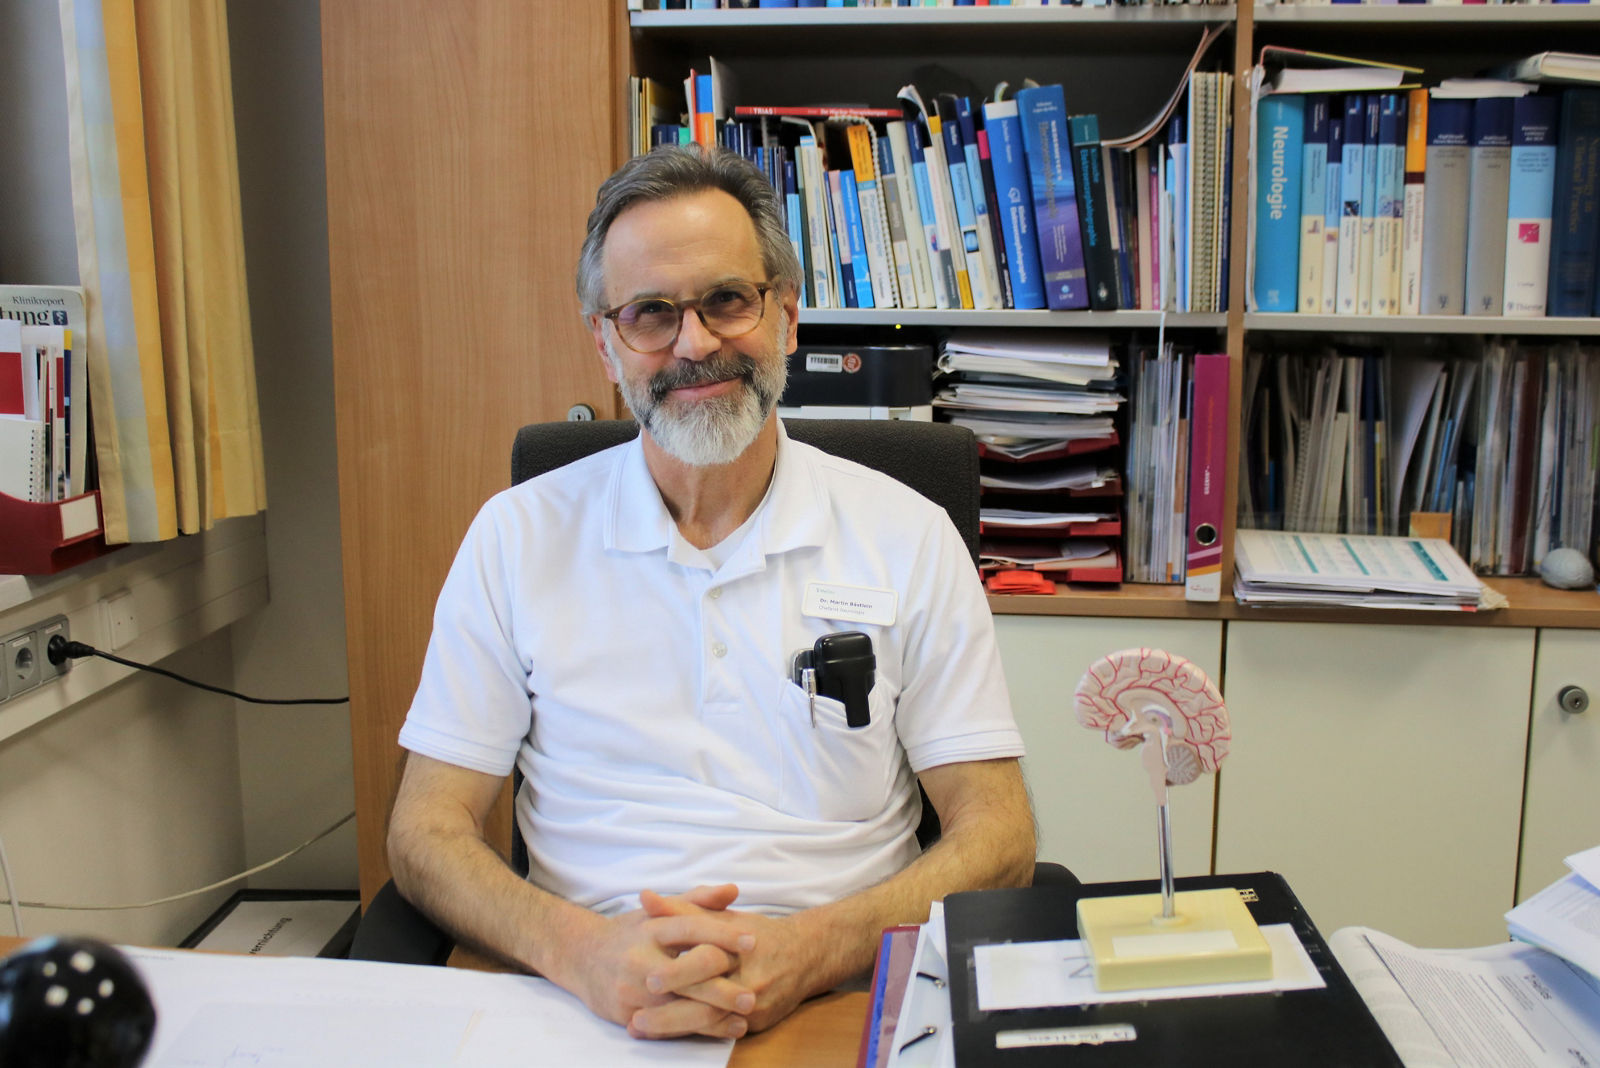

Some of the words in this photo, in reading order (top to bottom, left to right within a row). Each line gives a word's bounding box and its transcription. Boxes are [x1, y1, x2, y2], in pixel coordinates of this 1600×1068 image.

[753, 107, 773, 115] TRIAS
[1268, 126, 1289, 220] Neurologie
[12, 295, 65, 306] Klinikreport
[829, 599, 849, 607] Martin
